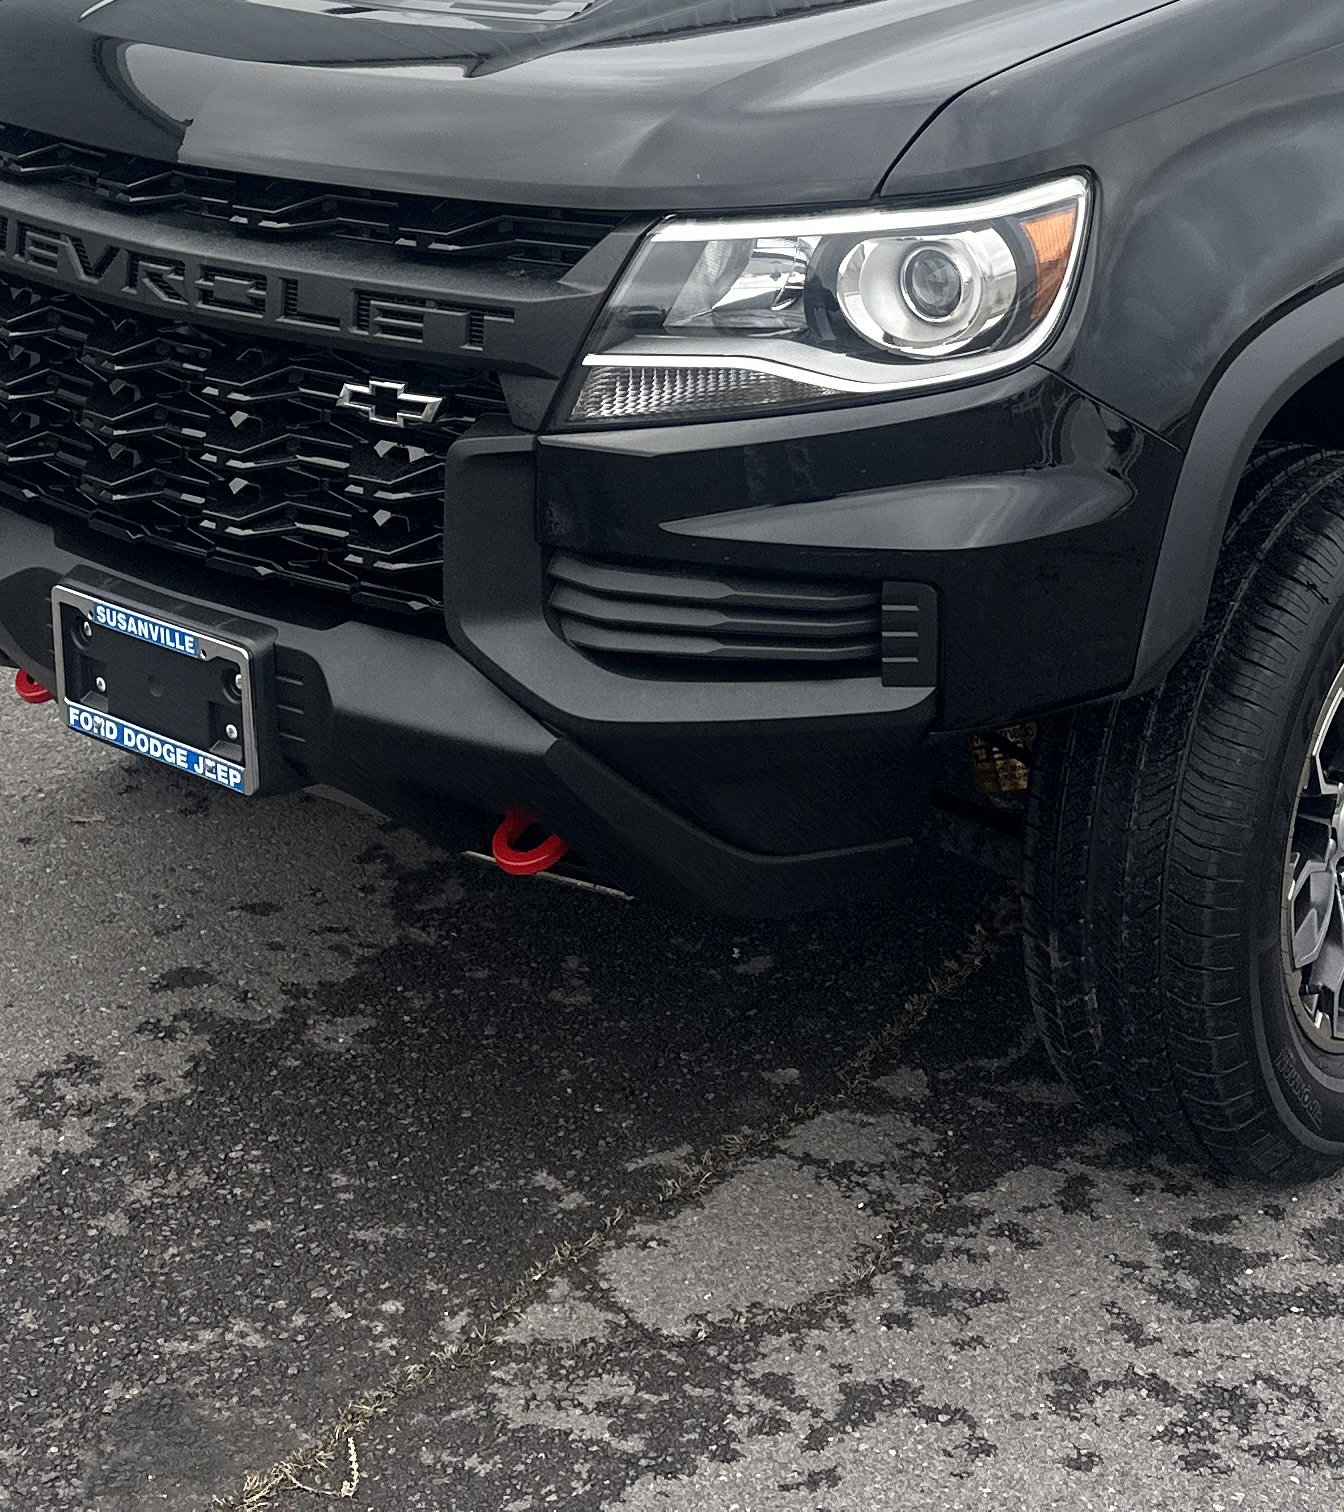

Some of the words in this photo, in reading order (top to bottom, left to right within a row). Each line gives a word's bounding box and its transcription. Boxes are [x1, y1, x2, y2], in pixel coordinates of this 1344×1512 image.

[95, 605, 197, 655] SUSANVILLE
[69, 707, 118, 741] FORD
[123, 727, 189, 770] DODGE
[193, 759, 242, 789] JEEP
